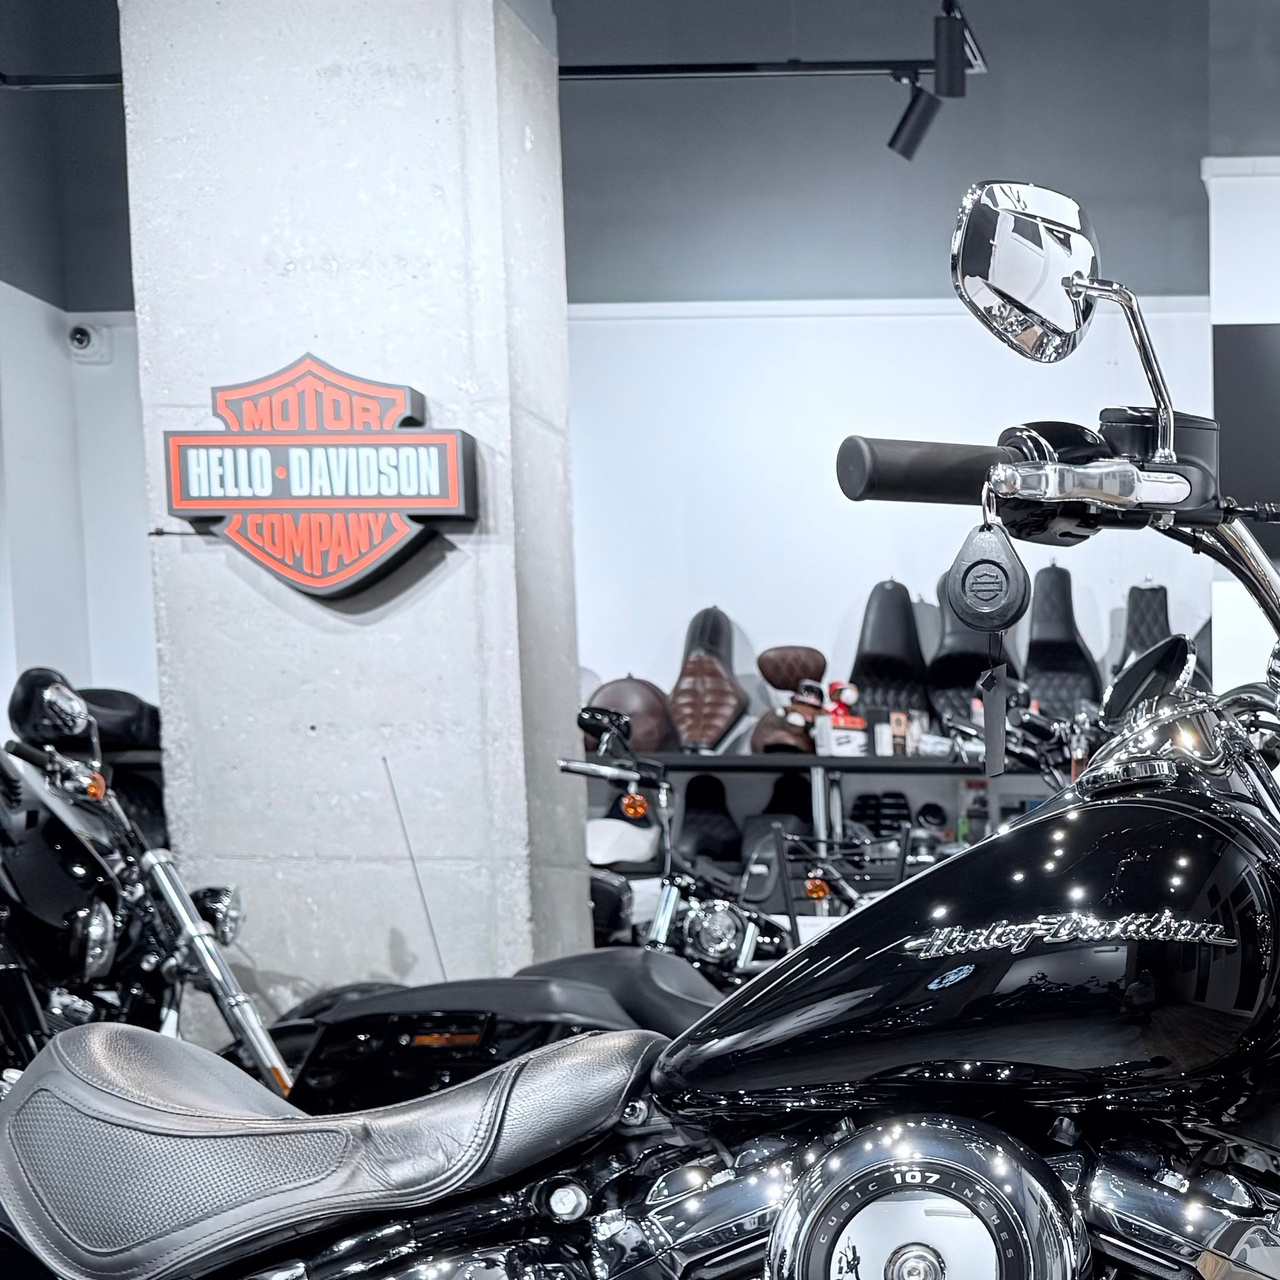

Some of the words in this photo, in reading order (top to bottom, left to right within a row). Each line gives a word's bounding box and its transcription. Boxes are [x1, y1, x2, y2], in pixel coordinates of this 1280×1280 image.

[241, 374, 381, 431] MOTOR
[186, 447, 273, 497] HELLO
[288, 446, 440, 497] DAVIDSON
[247, 512, 387, 576] COMPANY
[819, 1183, 878, 1244] CUBIC
[893, 1172, 941, 1184] 107
[951, 1182, 1014, 1259] INCHES
